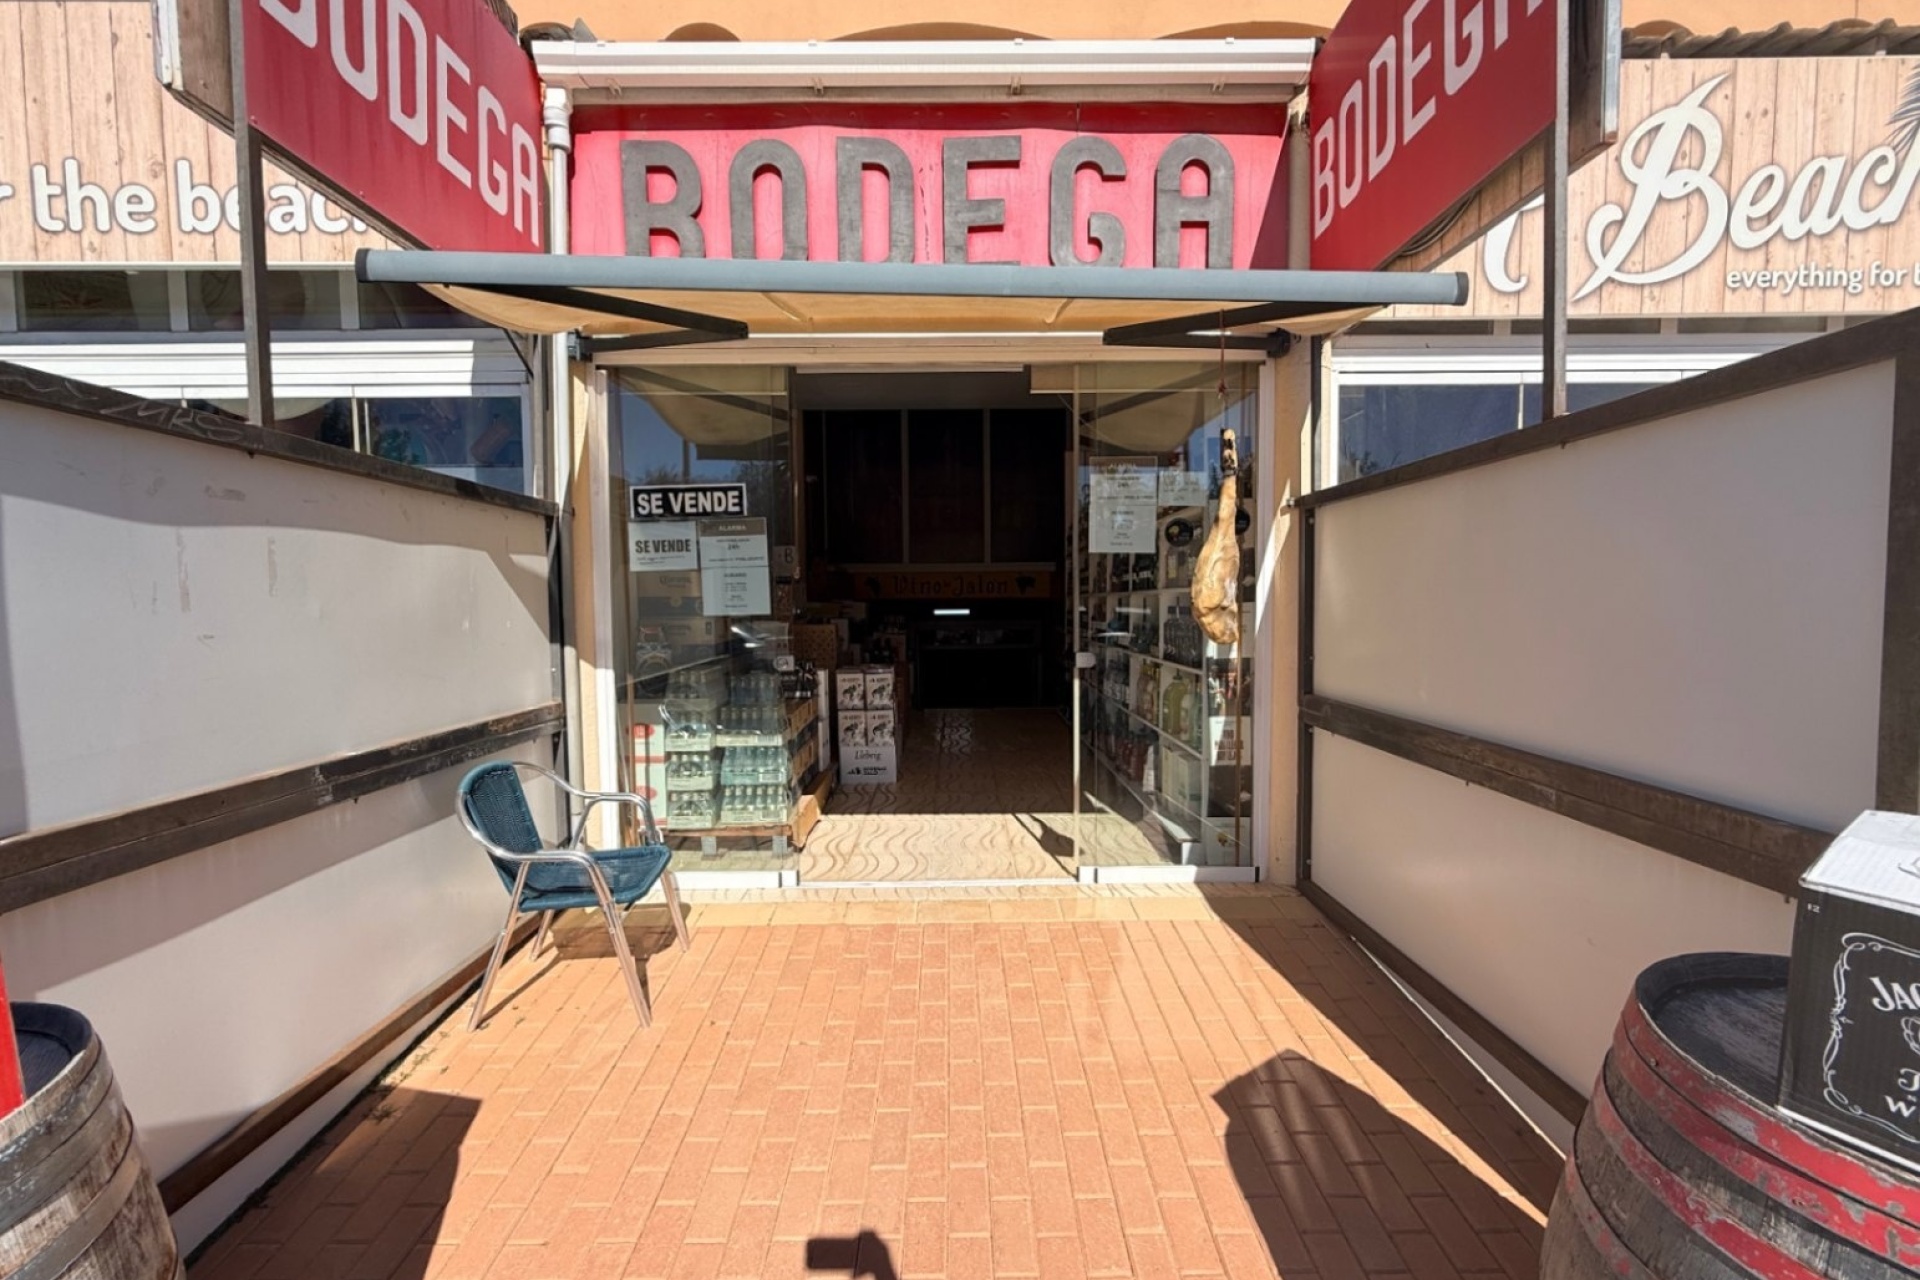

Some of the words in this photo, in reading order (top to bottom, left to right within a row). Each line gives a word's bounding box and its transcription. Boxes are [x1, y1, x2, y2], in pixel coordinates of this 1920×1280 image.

[259, 0, 540, 248] ODEGA
[31, 158, 157, 233] the
[619, 133, 1237, 270] BODEGA
[1726, 262, 1863, 295] everything
[1869, 261, 1907, 287] for
[637, 493, 664, 515] SE
[668, 490, 741, 514] VENDE
[635, 539, 653, 554] SE
[653, 538, 692, 554] VENDE
